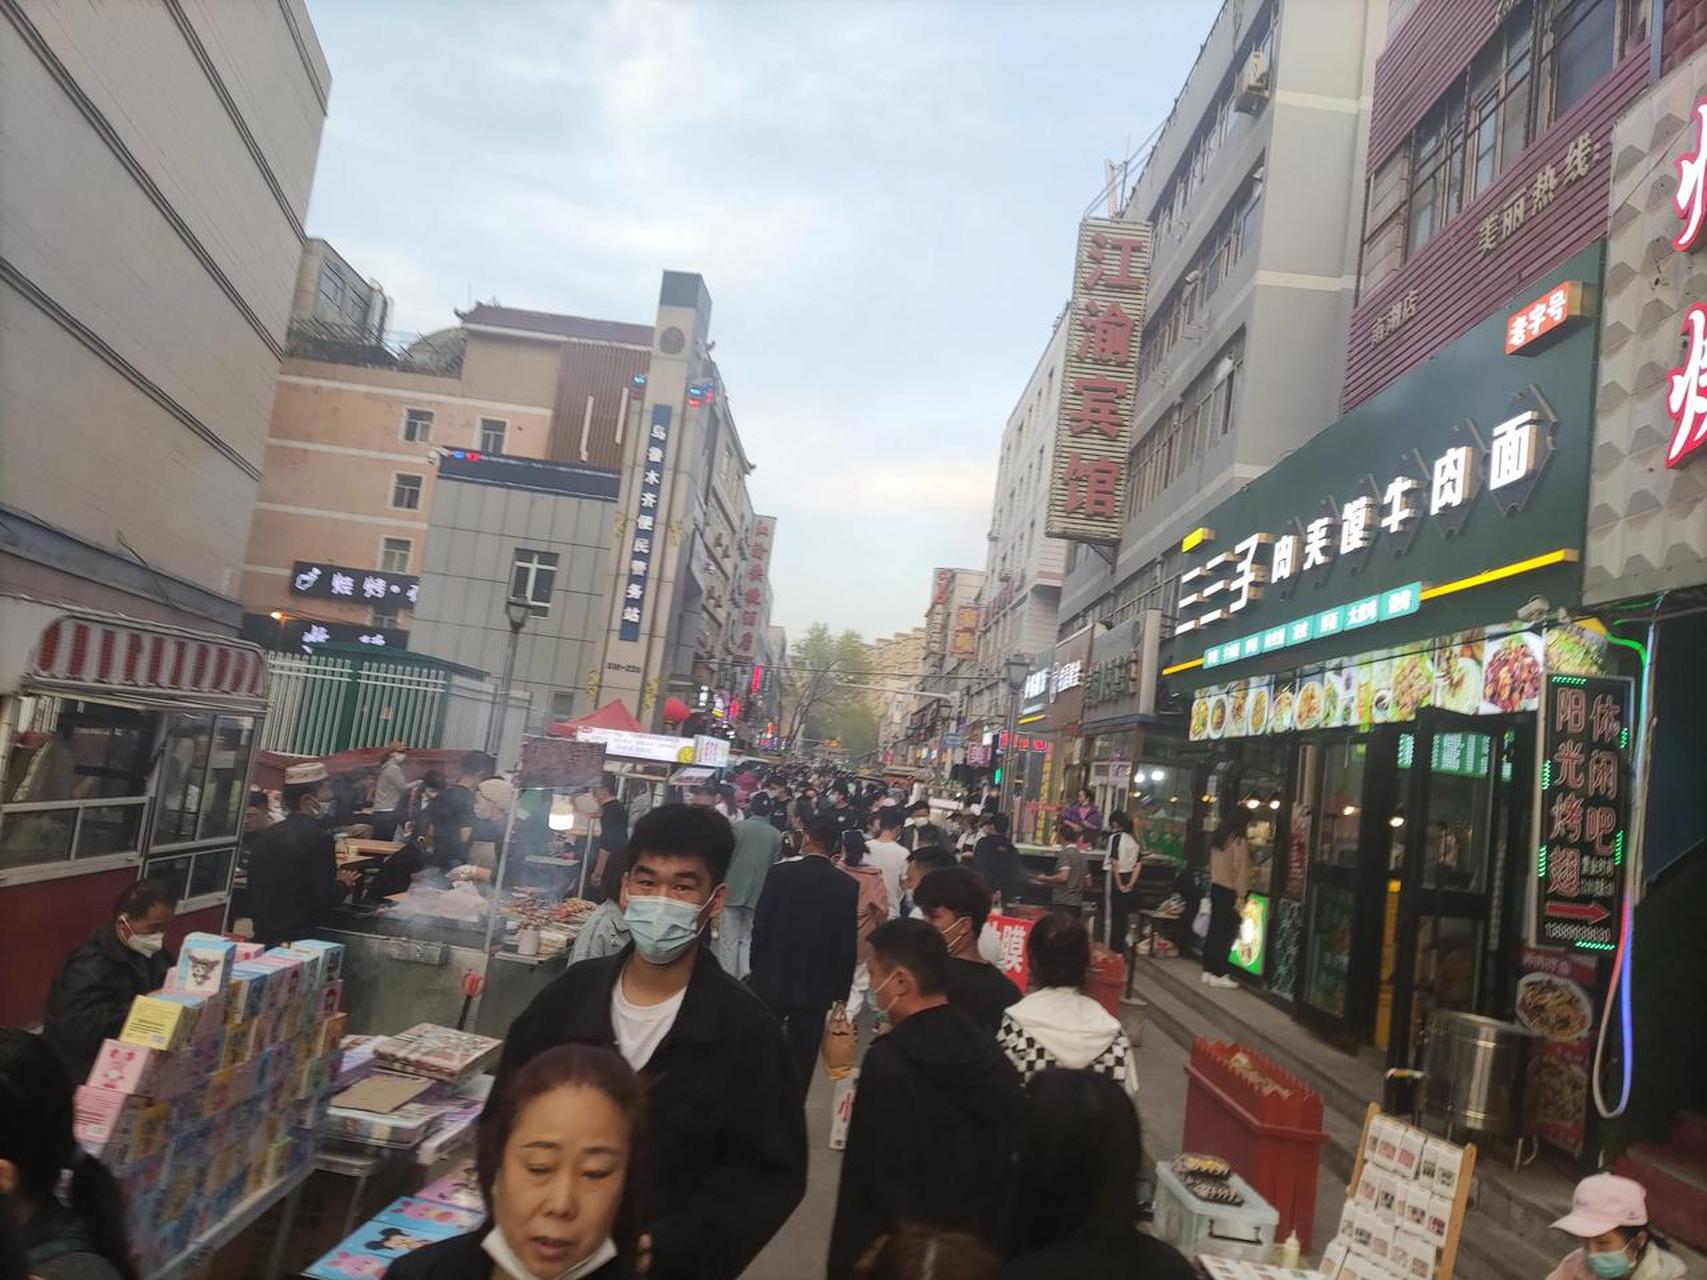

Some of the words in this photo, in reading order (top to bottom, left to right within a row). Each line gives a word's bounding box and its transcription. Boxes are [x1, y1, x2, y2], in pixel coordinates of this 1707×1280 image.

[1063, 231, 1143, 519] 江渝宾馆
[621, 424, 667, 623] 乌鲁木齐便民警务站
